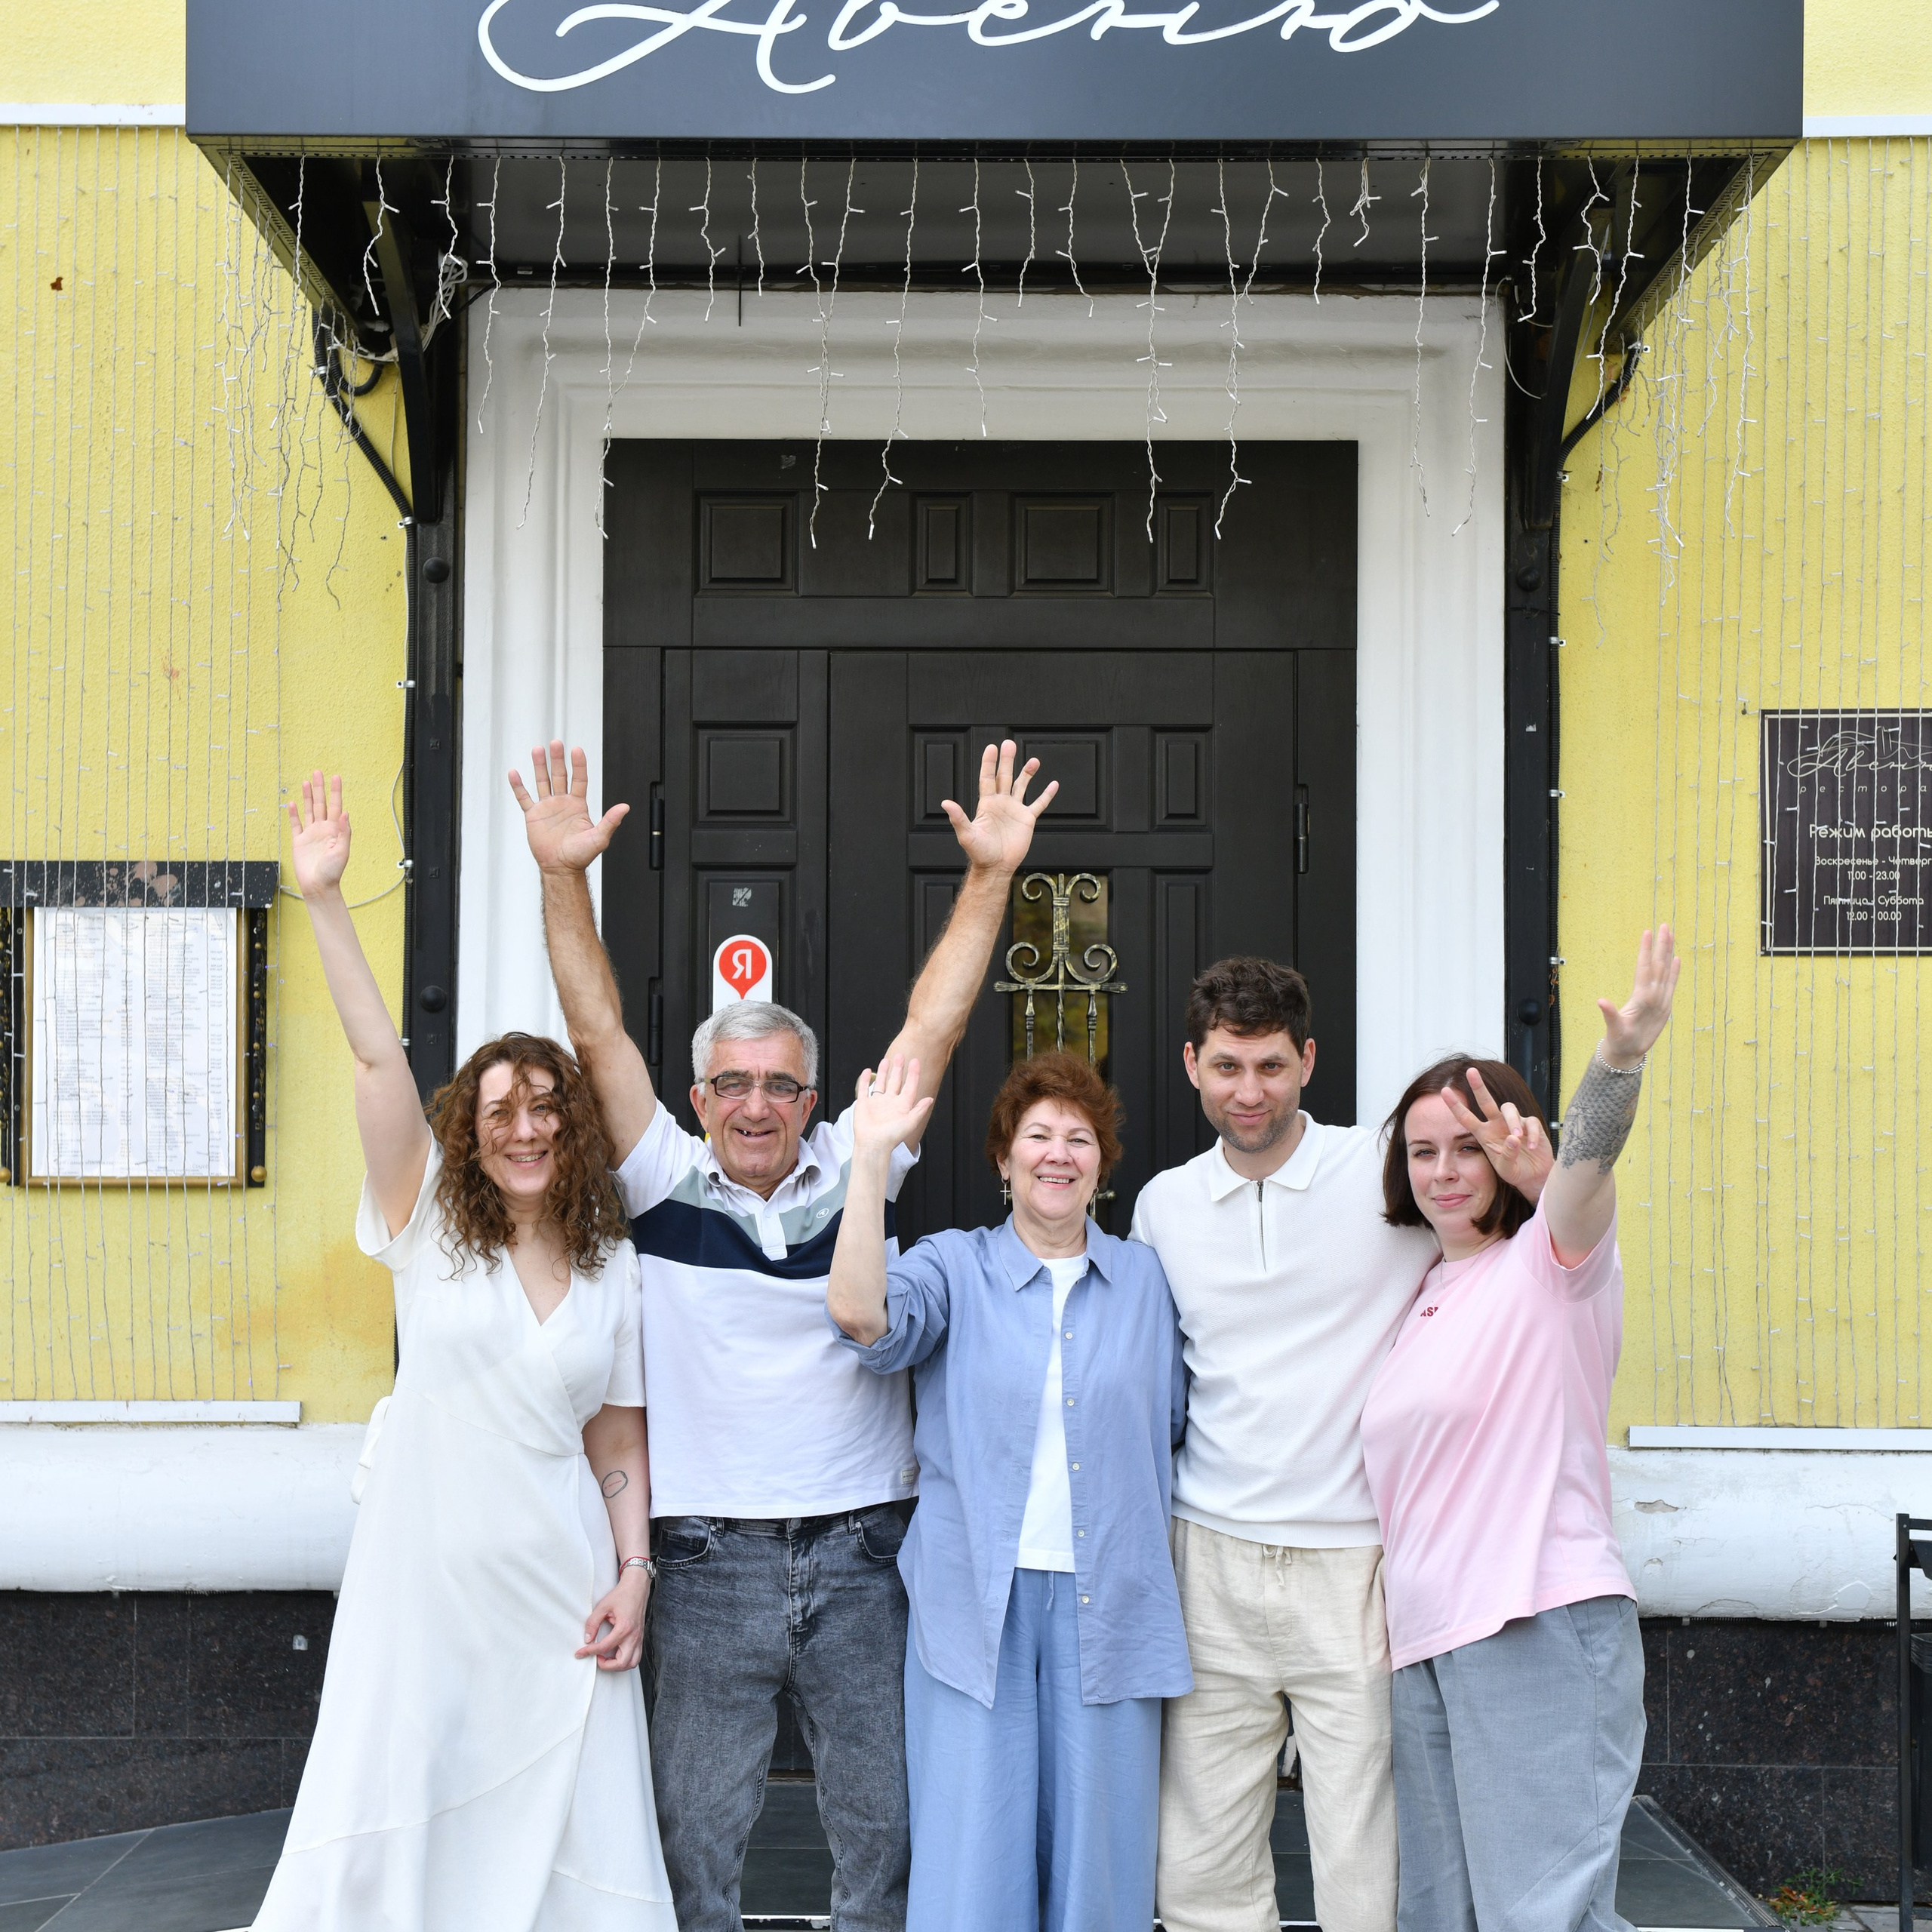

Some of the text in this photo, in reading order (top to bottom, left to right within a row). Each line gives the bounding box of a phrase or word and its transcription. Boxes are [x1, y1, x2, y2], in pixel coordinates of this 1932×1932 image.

[1809, 824, 1866, 838] Режим
[1815, 856, 1879, 866] Воскресенье
[1847, 870, 1866, 881] 11.00
[1875, 870, 1900, 881] 23.00
[1878, 895, 1924, 907] Суббота
[1846, 911, 1868, 921] 12.00
[1878, 911, 1902, 921] 00.00
[731, 949, 752, 980] Я
